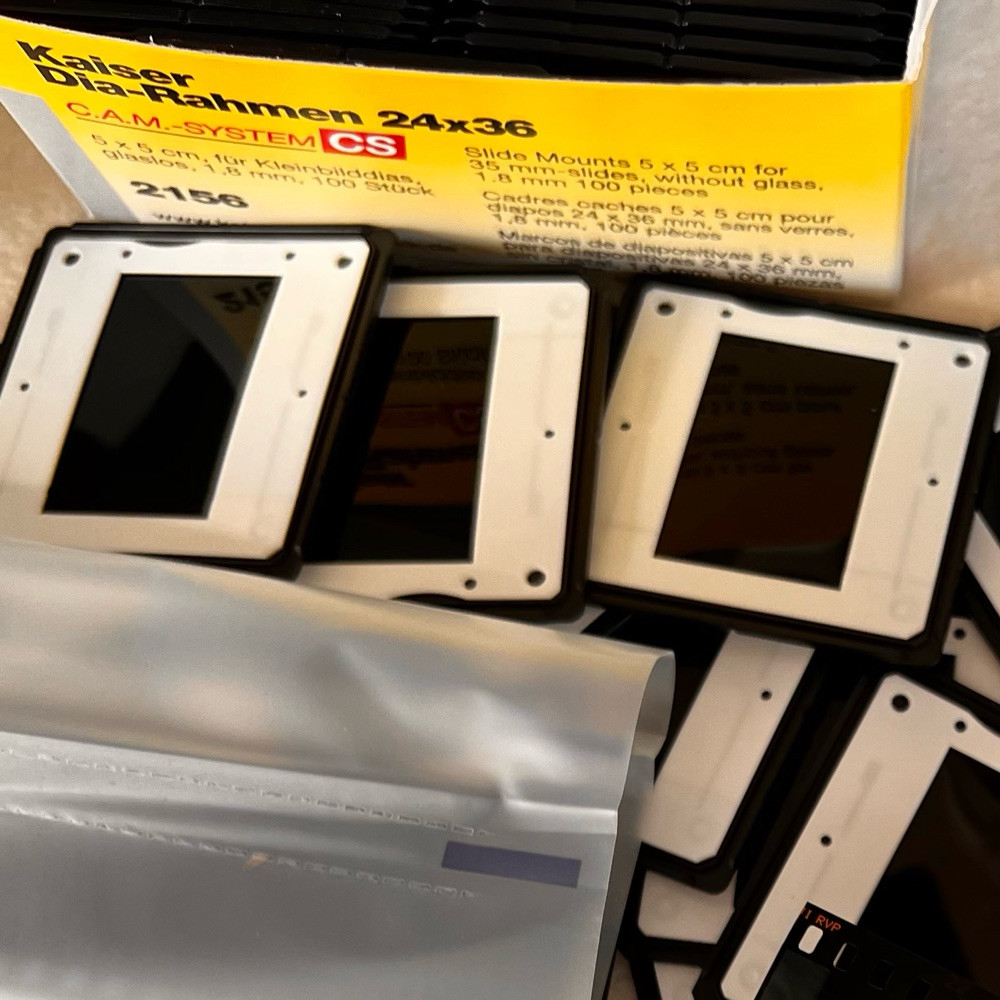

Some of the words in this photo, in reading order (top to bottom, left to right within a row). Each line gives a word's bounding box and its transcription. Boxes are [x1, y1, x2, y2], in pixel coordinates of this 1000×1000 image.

[16, 39, 195, 88] Kaiser
[34, 62, 364, 125] Dia-Rahmen
[377, 109, 538, 139] 24x36
[66, 101, 316, 148] C.A.M.-SYSTEM
[328, 131, 398, 157] CS
[91, 133, 108, 147] 5
[115, 140, 131, 151] x
[136, 142, 153, 154] 5
[214, 153, 247, 166] für
[254, 157, 424, 186] Kleinbilddias,
[102, 149, 198, 173] glaslos,
[314, 175, 357, 190] 100
[364, 181, 436, 198] Stück
[463, 145, 528, 162] Slide
[535, 151, 631, 170] Mounts
[639, 158, 654, 171] 5
[662, 161, 677, 172] x
[685, 160, 700, 173] 5
[707, 162, 747, 175] cm
[753, 163, 789, 177] for
[469, 158, 501, 172] 35
[508, 163, 646, 184] mm-slides,
[653, 172, 746, 188] without
[752, 176, 825, 192] glass,
[130, 180, 250, 209] 2156
[520, 175, 568, 188] mm
[574, 178, 622, 193] 100
[629, 182, 709, 199] pieces
[481, 189, 569, 208] Cadres
[576, 199, 663, 215] caches
[670, 204, 685, 217] 5
[692, 208, 706, 219] x
[713, 207, 728, 220] 5
[735, 210, 773, 223] cm
[779, 211, 836, 226] pour
[486, 202, 565, 218] diapos
[571, 208, 599, 221] 24
[606, 212, 620, 223] x
[626, 212, 656, 226] 36
[719, 219, 773, 234] sans
[779, 223, 857, 239] verres,
[596, 221, 639, 235] 100
[587, 238, 616, 251] de
[622, 241, 753, 264] diapositivas
[759, 252, 774, 265] 5
[780, 256, 793, 266] x
[800, 255, 814, 268] 5
[819, 257, 856, 270] cm
[702, 258, 731, 271] 24
[757, 263, 786, 276] 36
[773, 276, 847, 291] piezas
[814, 914, 843, 932] RVP
